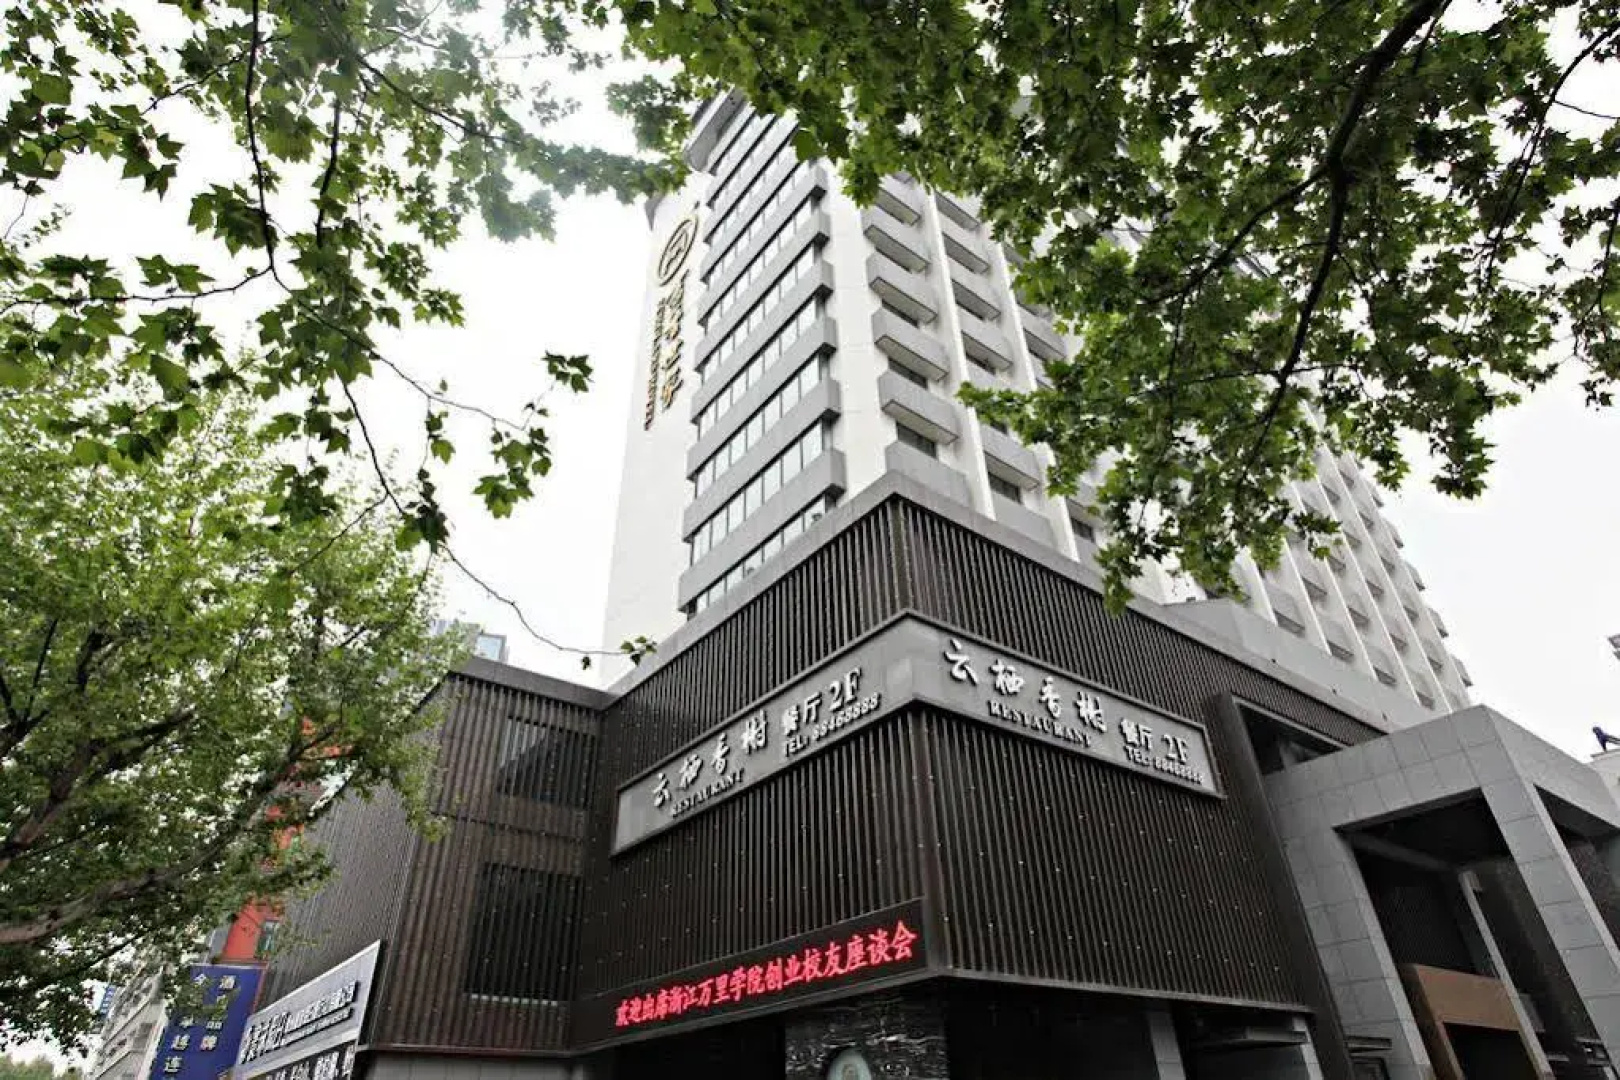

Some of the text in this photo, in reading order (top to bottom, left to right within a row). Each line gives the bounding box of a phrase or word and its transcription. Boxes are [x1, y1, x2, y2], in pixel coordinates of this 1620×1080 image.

[782, 691, 822, 736] 餐厅
[829, 666, 862, 713] 2F
[987, 699, 1093, 748] RESTAURANT
[1119, 718, 1153, 750] 餐厅
[1161, 733, 1189, 765] 2F
[615, 920, 917, 1027] 欢迎出席浙江万里学院创业校友座谈会
[199, 974, 237, 1051] 酒品牌
